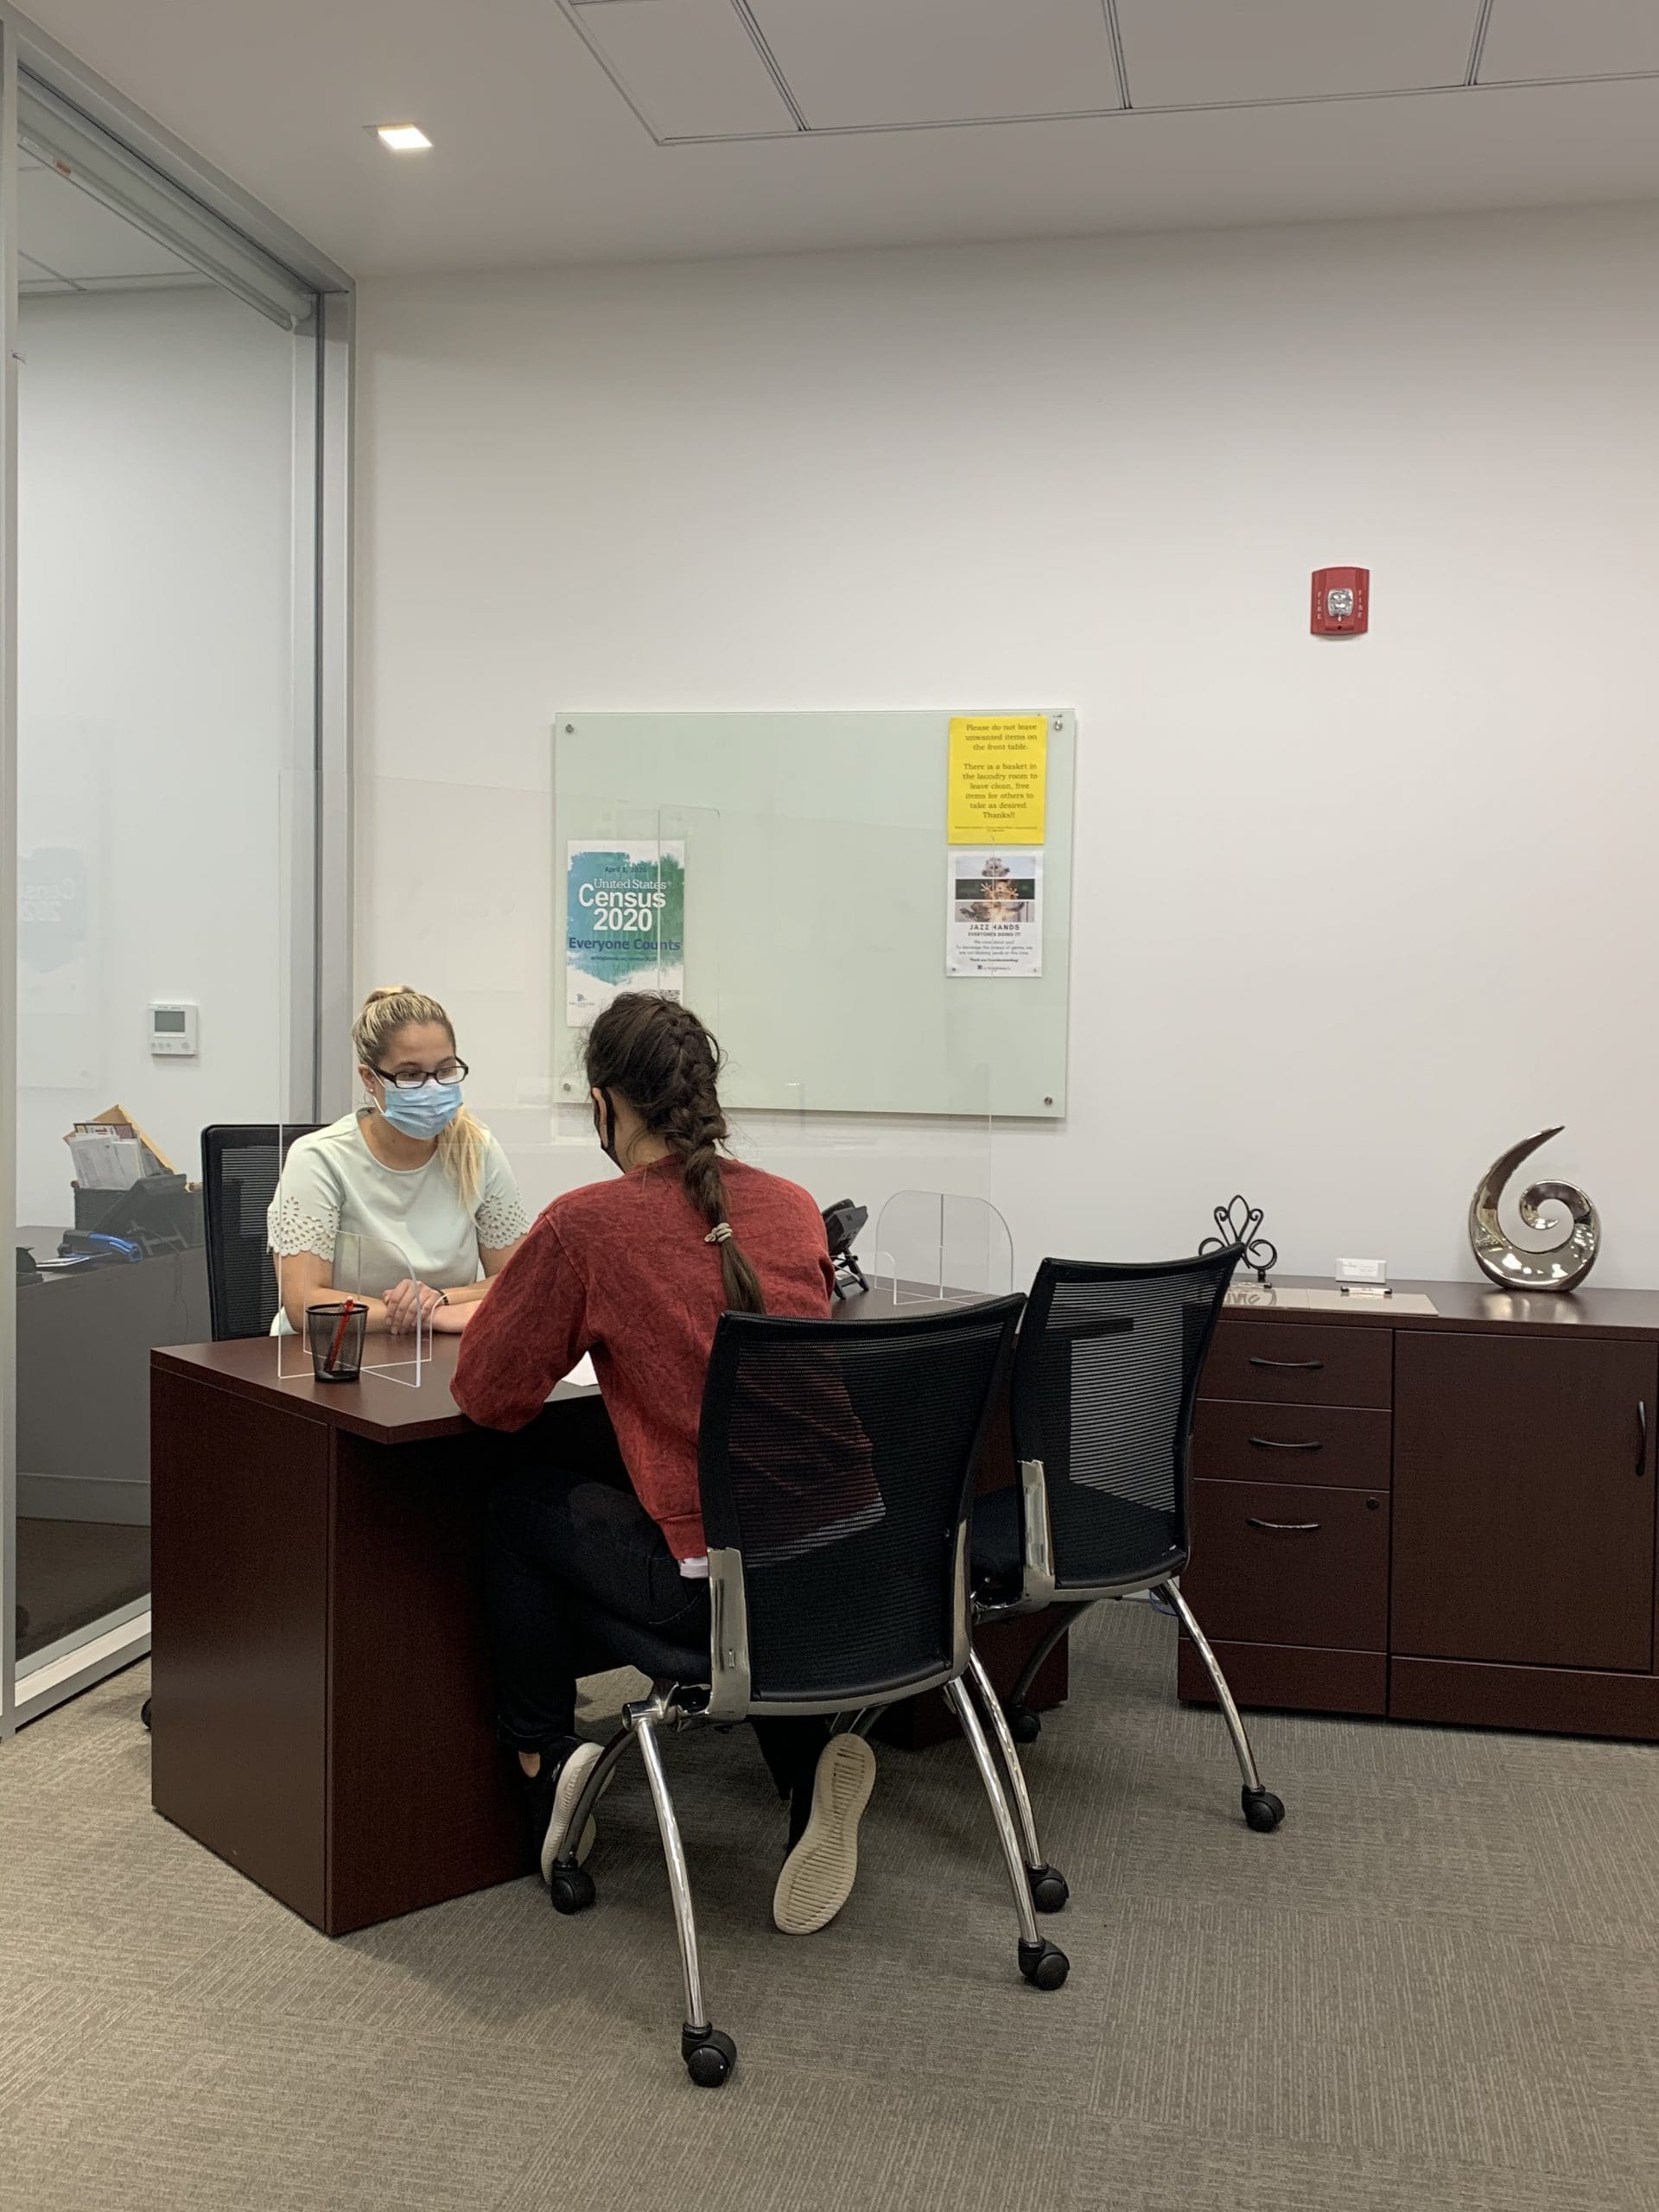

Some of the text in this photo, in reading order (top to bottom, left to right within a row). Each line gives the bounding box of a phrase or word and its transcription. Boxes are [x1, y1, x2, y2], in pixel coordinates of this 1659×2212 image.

[594, 878, 666, 890] United States
[578, 883, 666, 909] Census
[593, 908, 652, 932] 2020
[569, 938, 681, 952] Everyone Counts
